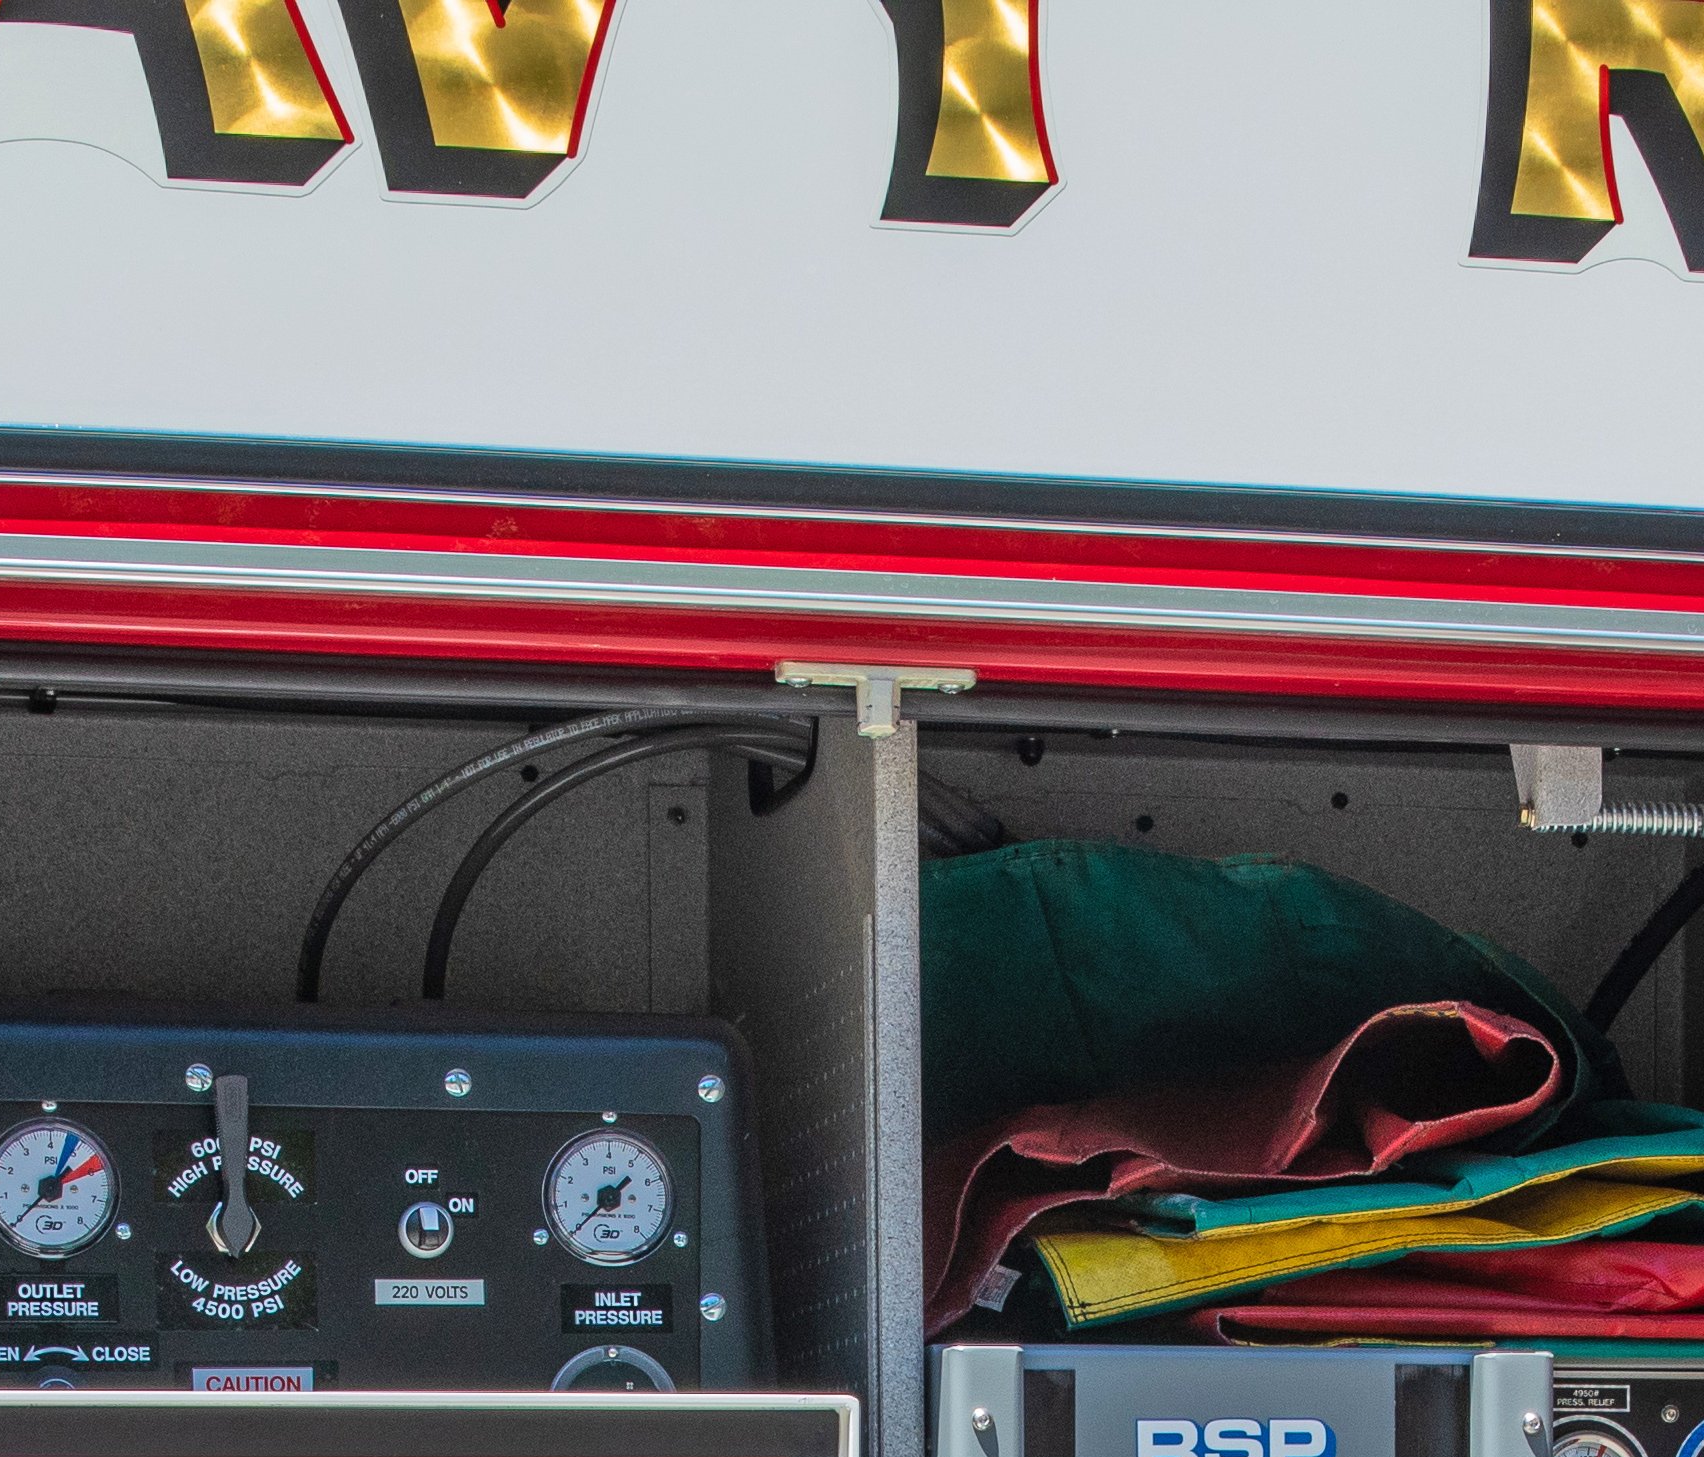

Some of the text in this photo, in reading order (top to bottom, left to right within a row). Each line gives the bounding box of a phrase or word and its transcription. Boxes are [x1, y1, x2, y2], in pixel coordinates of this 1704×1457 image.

[249, 1136, 282, 1160] PSI
[44, 1156, 58, 1166] PSI
[405, 1169, 439, 1185] OFF
[602, 1166, 616, 1175] PSI
[168, 1161, 207, 1198] HIGH
[449, 1197, 474, 1214] ON
[170, 1259, 302, 1300] LOW PRESSURE
[17, 1283, 86, 1299] OUTLET
[392, 1286, 469, 1299] 220 VOLTS
[192, 1295, 286, 1320] 4500 PSI
[594, 1292, 642, 1307] INLET
[7, 1301, 100, 1317] PRESSURE
[574, 1310, 663, 1326] PRESSURE
[92, 1346, 151, 1361] CLOSE
[206, 1375, 301, 1391] CAUTION
[1557, 1398, 1585, 1406] PRESS.
